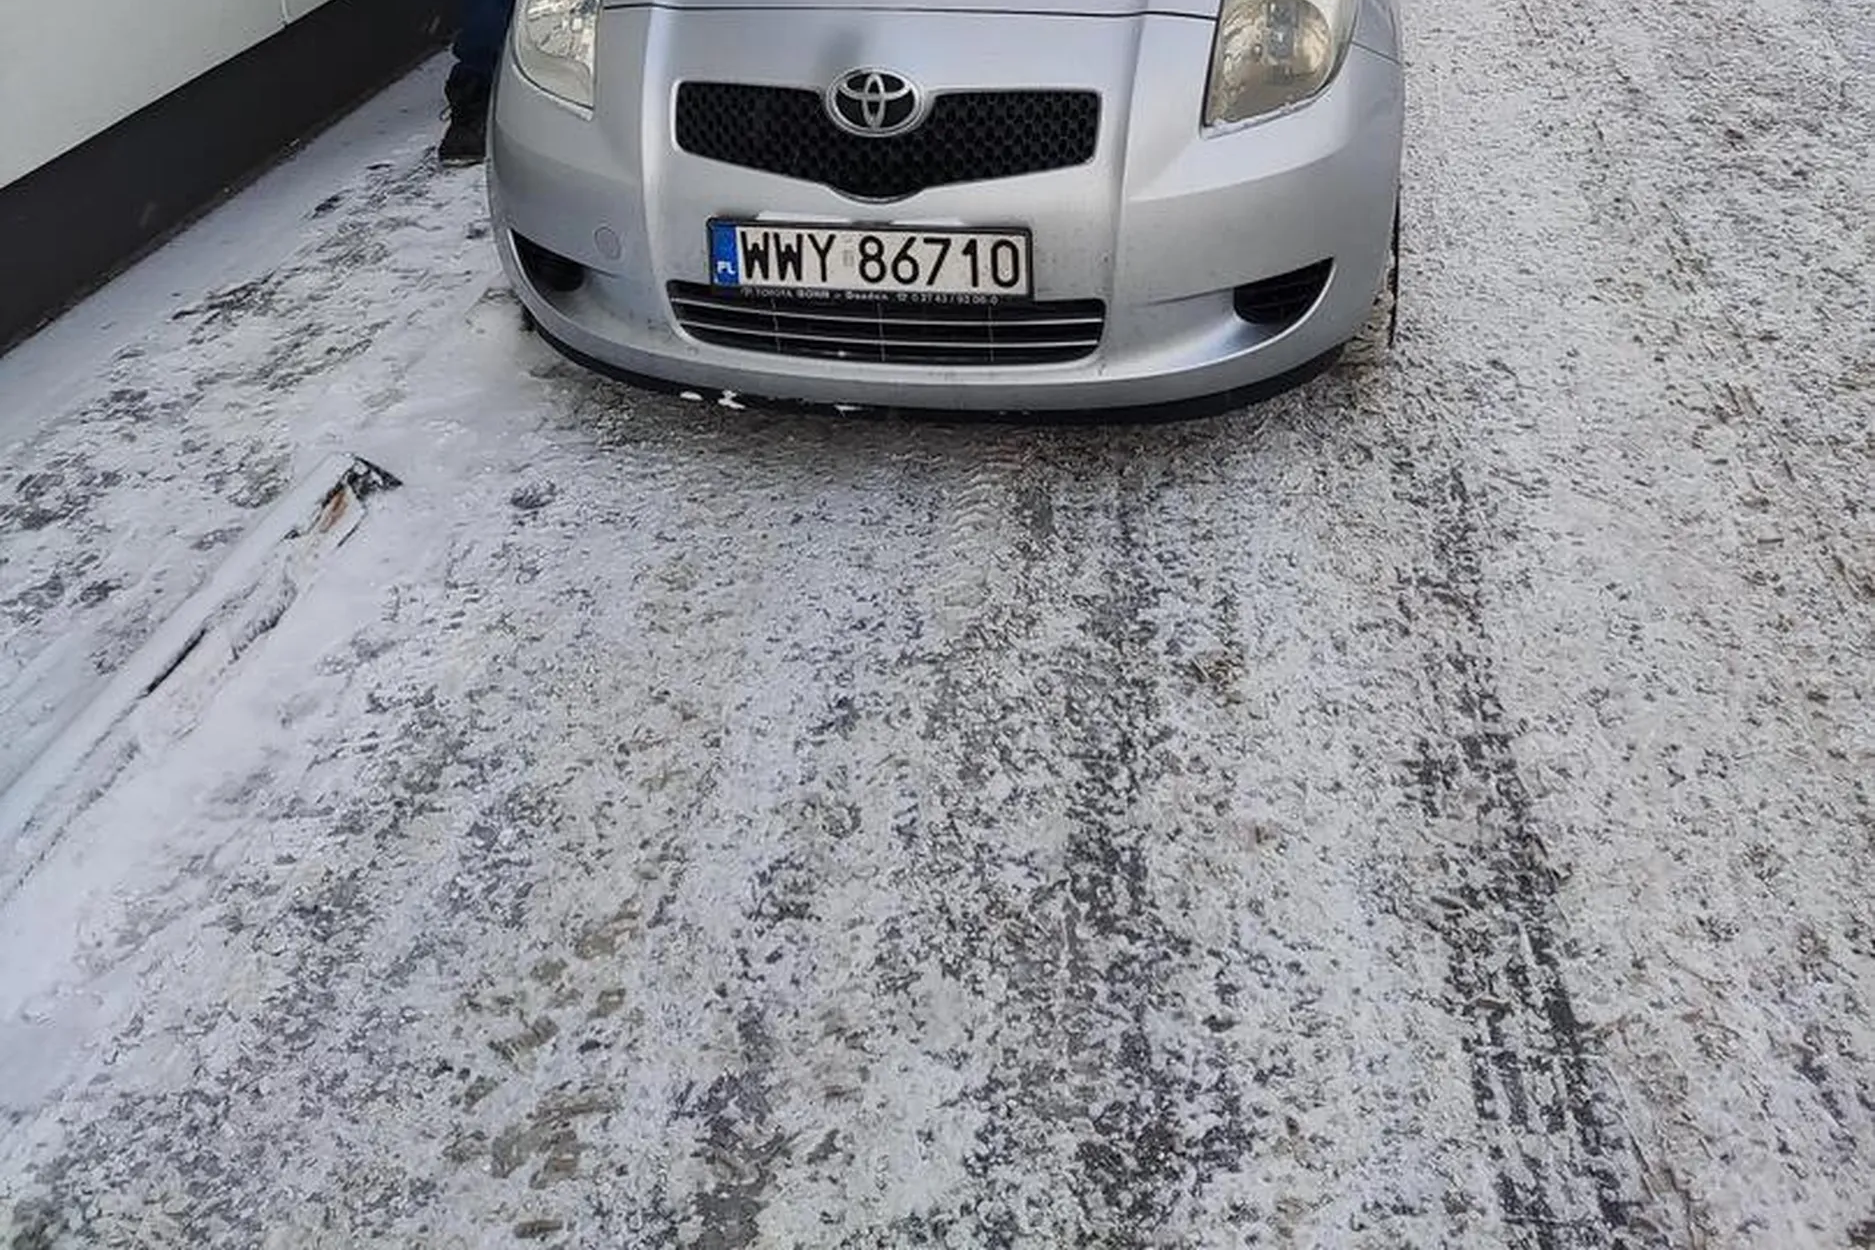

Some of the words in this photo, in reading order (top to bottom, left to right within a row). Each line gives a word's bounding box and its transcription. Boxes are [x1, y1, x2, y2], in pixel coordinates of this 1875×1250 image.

[740, 231, 837, 283] WWY
[858, 234, 1020, 289] 86710
[716, 261, 736, 275] PL
[754, 288, 794, 298] TOYOTA
